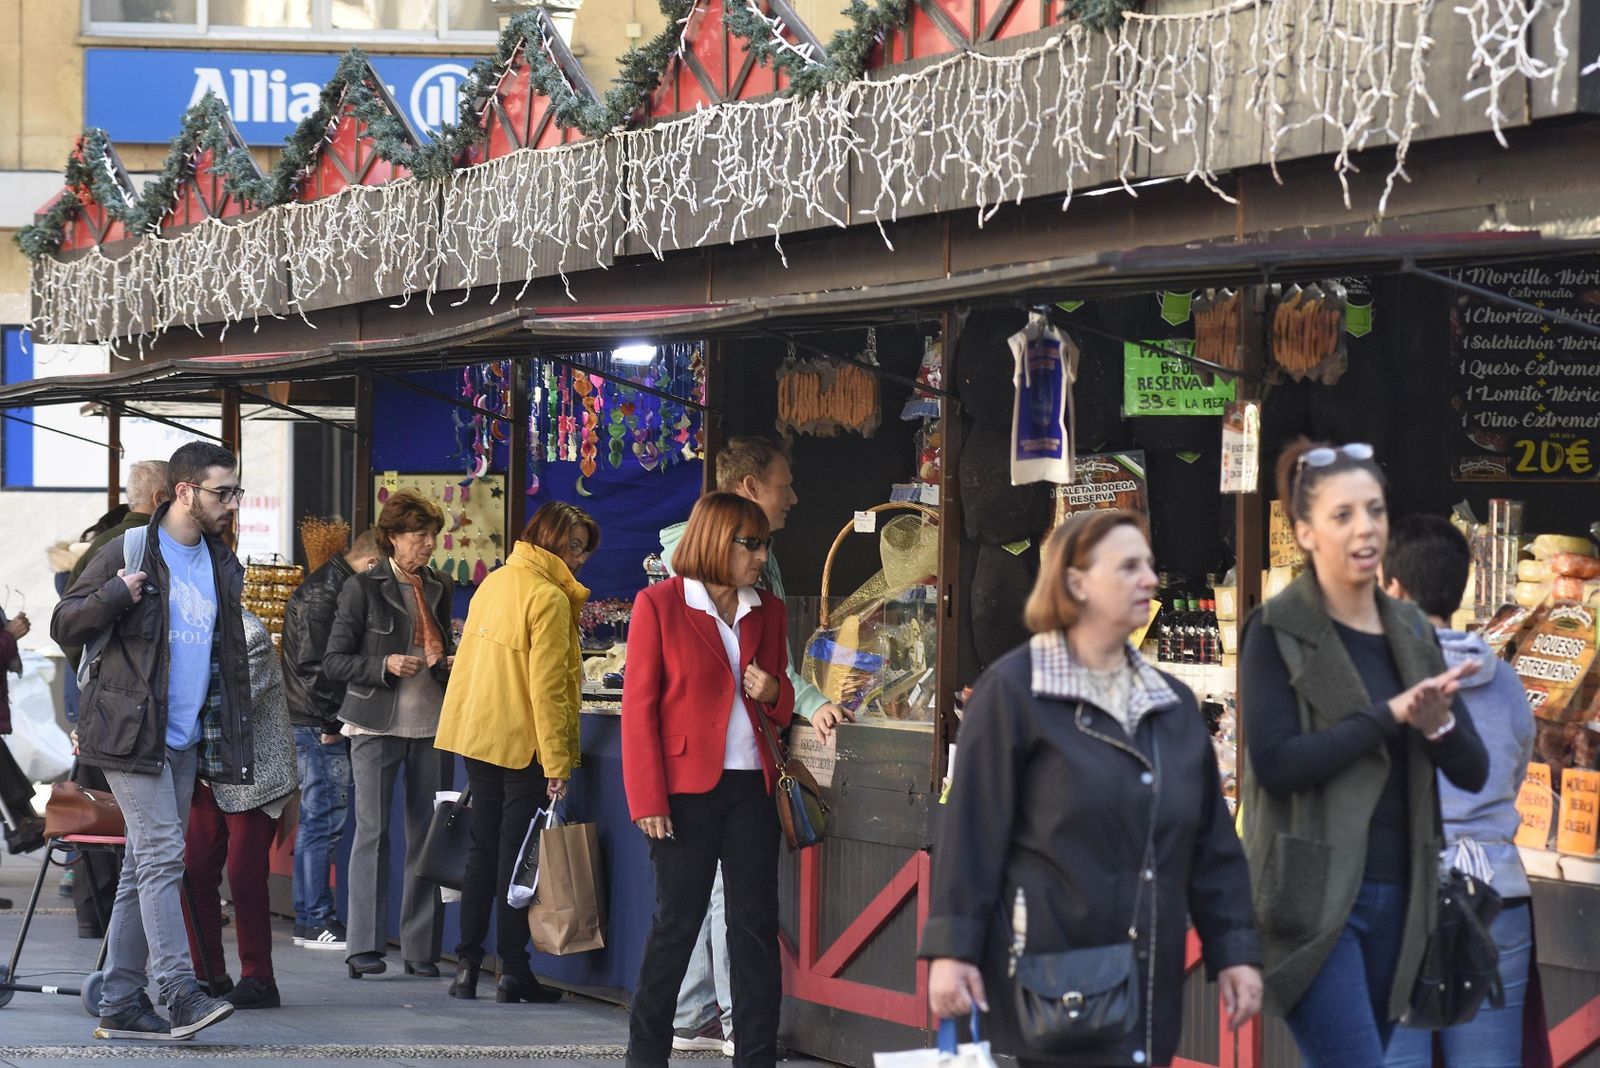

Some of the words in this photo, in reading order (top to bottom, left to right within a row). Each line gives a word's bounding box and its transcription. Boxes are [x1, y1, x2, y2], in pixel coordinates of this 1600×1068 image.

[187, 68, 395, 123] Allia
[1466, 267, 1552, 287] Morcilla
[1507, 286, 1574, 298] Extremeña
[1464, 307, 1471, 324] 1
[1473, 306, 1544, 324] Chorizo
[1463, 335, 1469, 350] 1
[1470, 334, 1555, 351] Salchichón
[1459, 360, 1466, 375] 1
[1469, 360, 1522, 379] Queso
[1524, 360, 1600, 376] Extreme
[1137, 376, 1202, 391] RESERVA
[1466, 385, 1473, 401] 1
[1475, 384, 1543, 402] Lomito
[1185, 399, 1199, 409] LA
[1461, 411, 1468, 428] 1
[1474, 411, 1519, 428] Vino
[1514, 439, 1593, 474] 20€
[1057, 485, 1093, 497] PALETA
[1093, 480, 1137, 493] BODEGA
[1069, 492, 1116, 505] RESERVA
[168, 629, 213, 645] POL
[1541, 634, 1586, 659] QUESOS
[1515, 655, 1581, 682] EXTREMEÑOS
